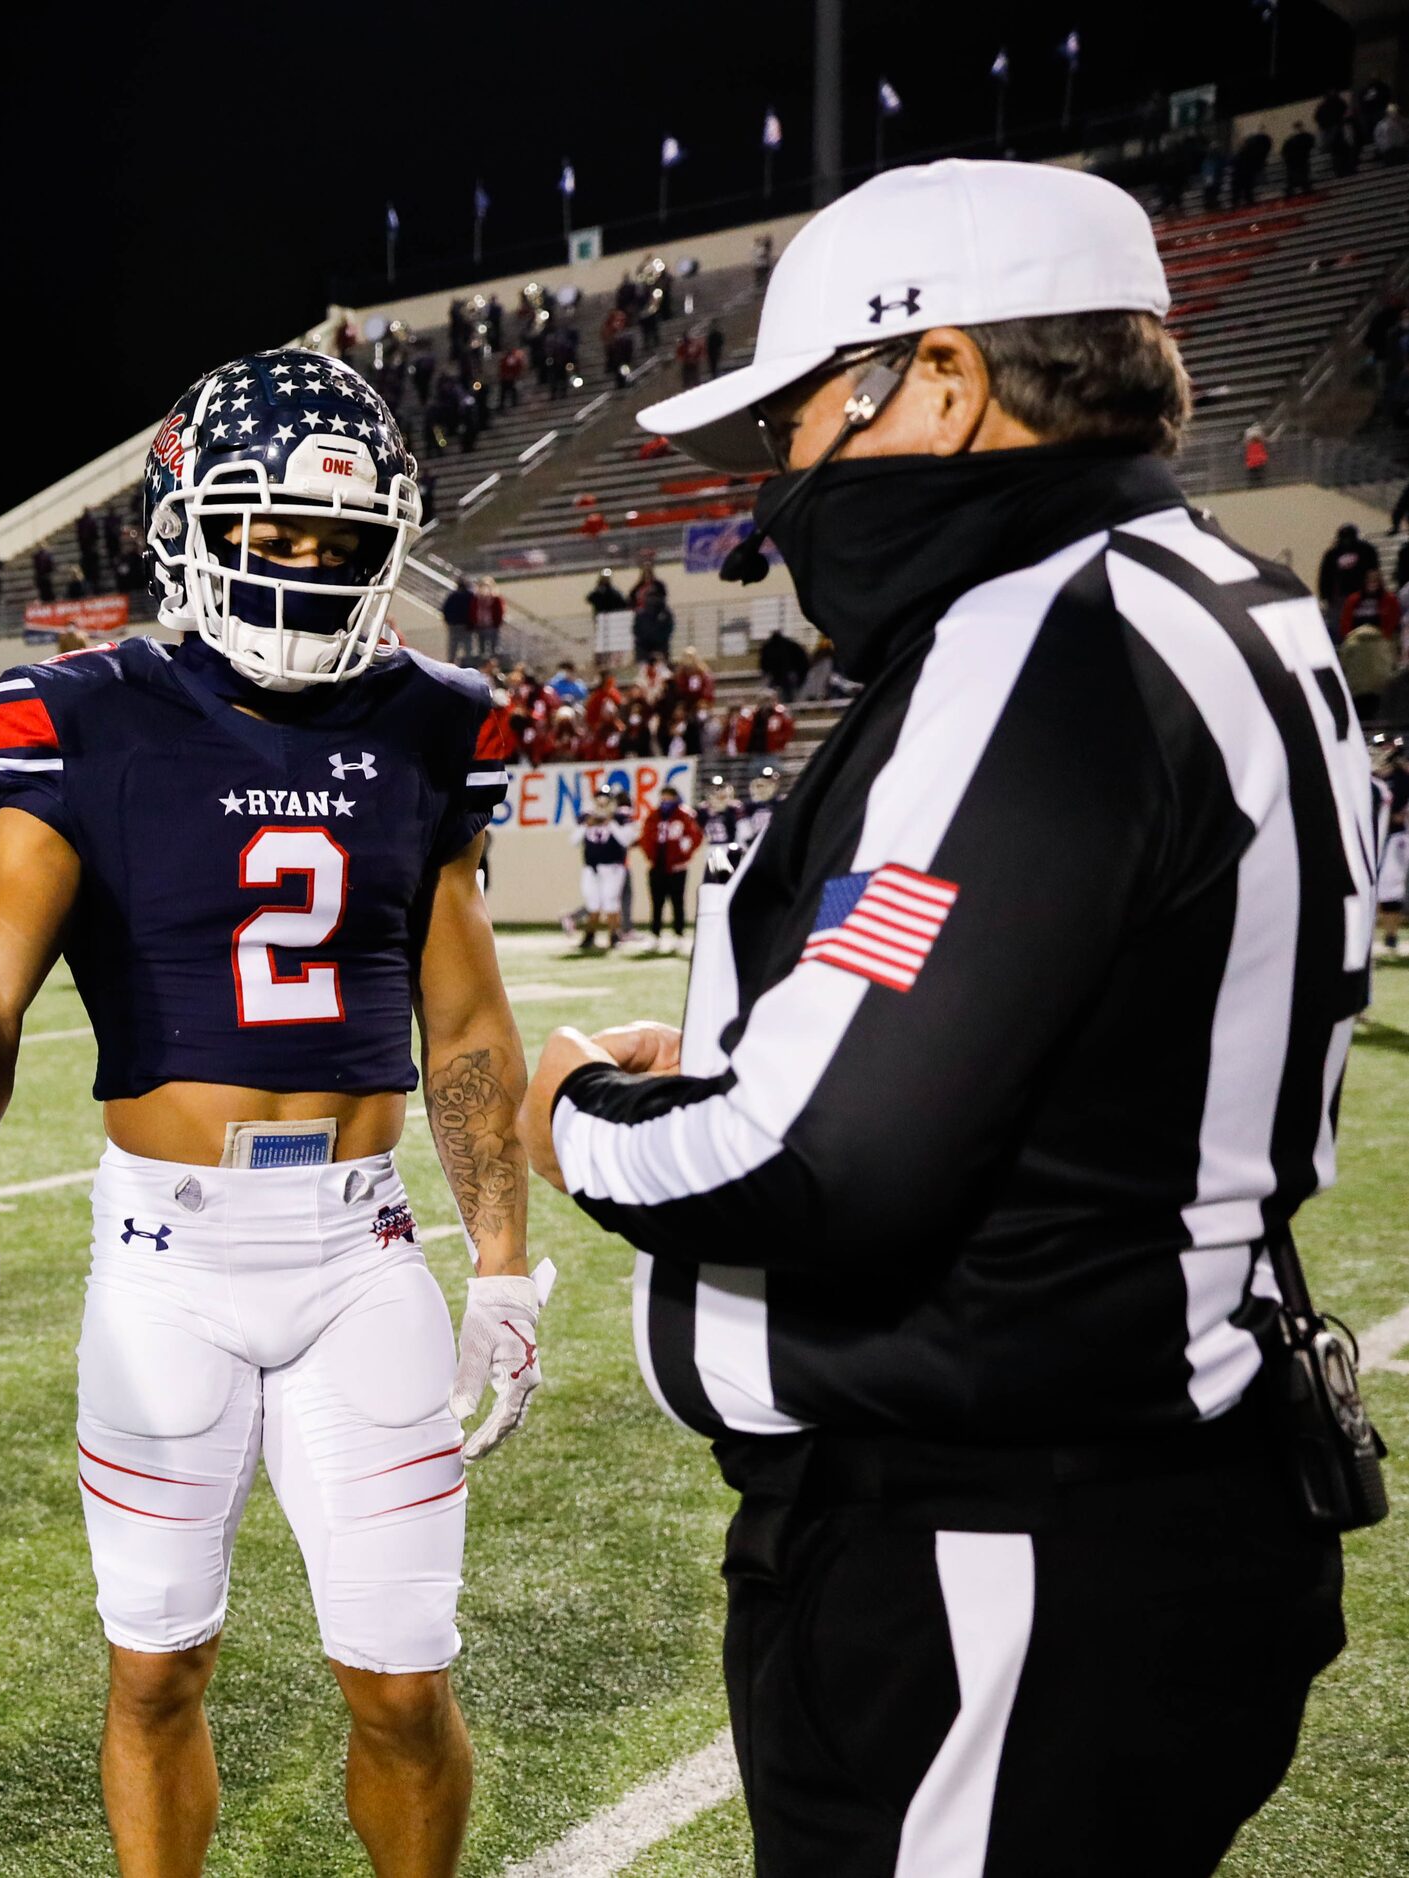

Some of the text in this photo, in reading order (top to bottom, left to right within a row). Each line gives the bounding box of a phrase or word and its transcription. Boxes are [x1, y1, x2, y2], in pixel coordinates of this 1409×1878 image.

[323, 457, 353, 477] ONE
[246, 789, 329, 817] RYAN
[230, 825, 350, 1029] 2
